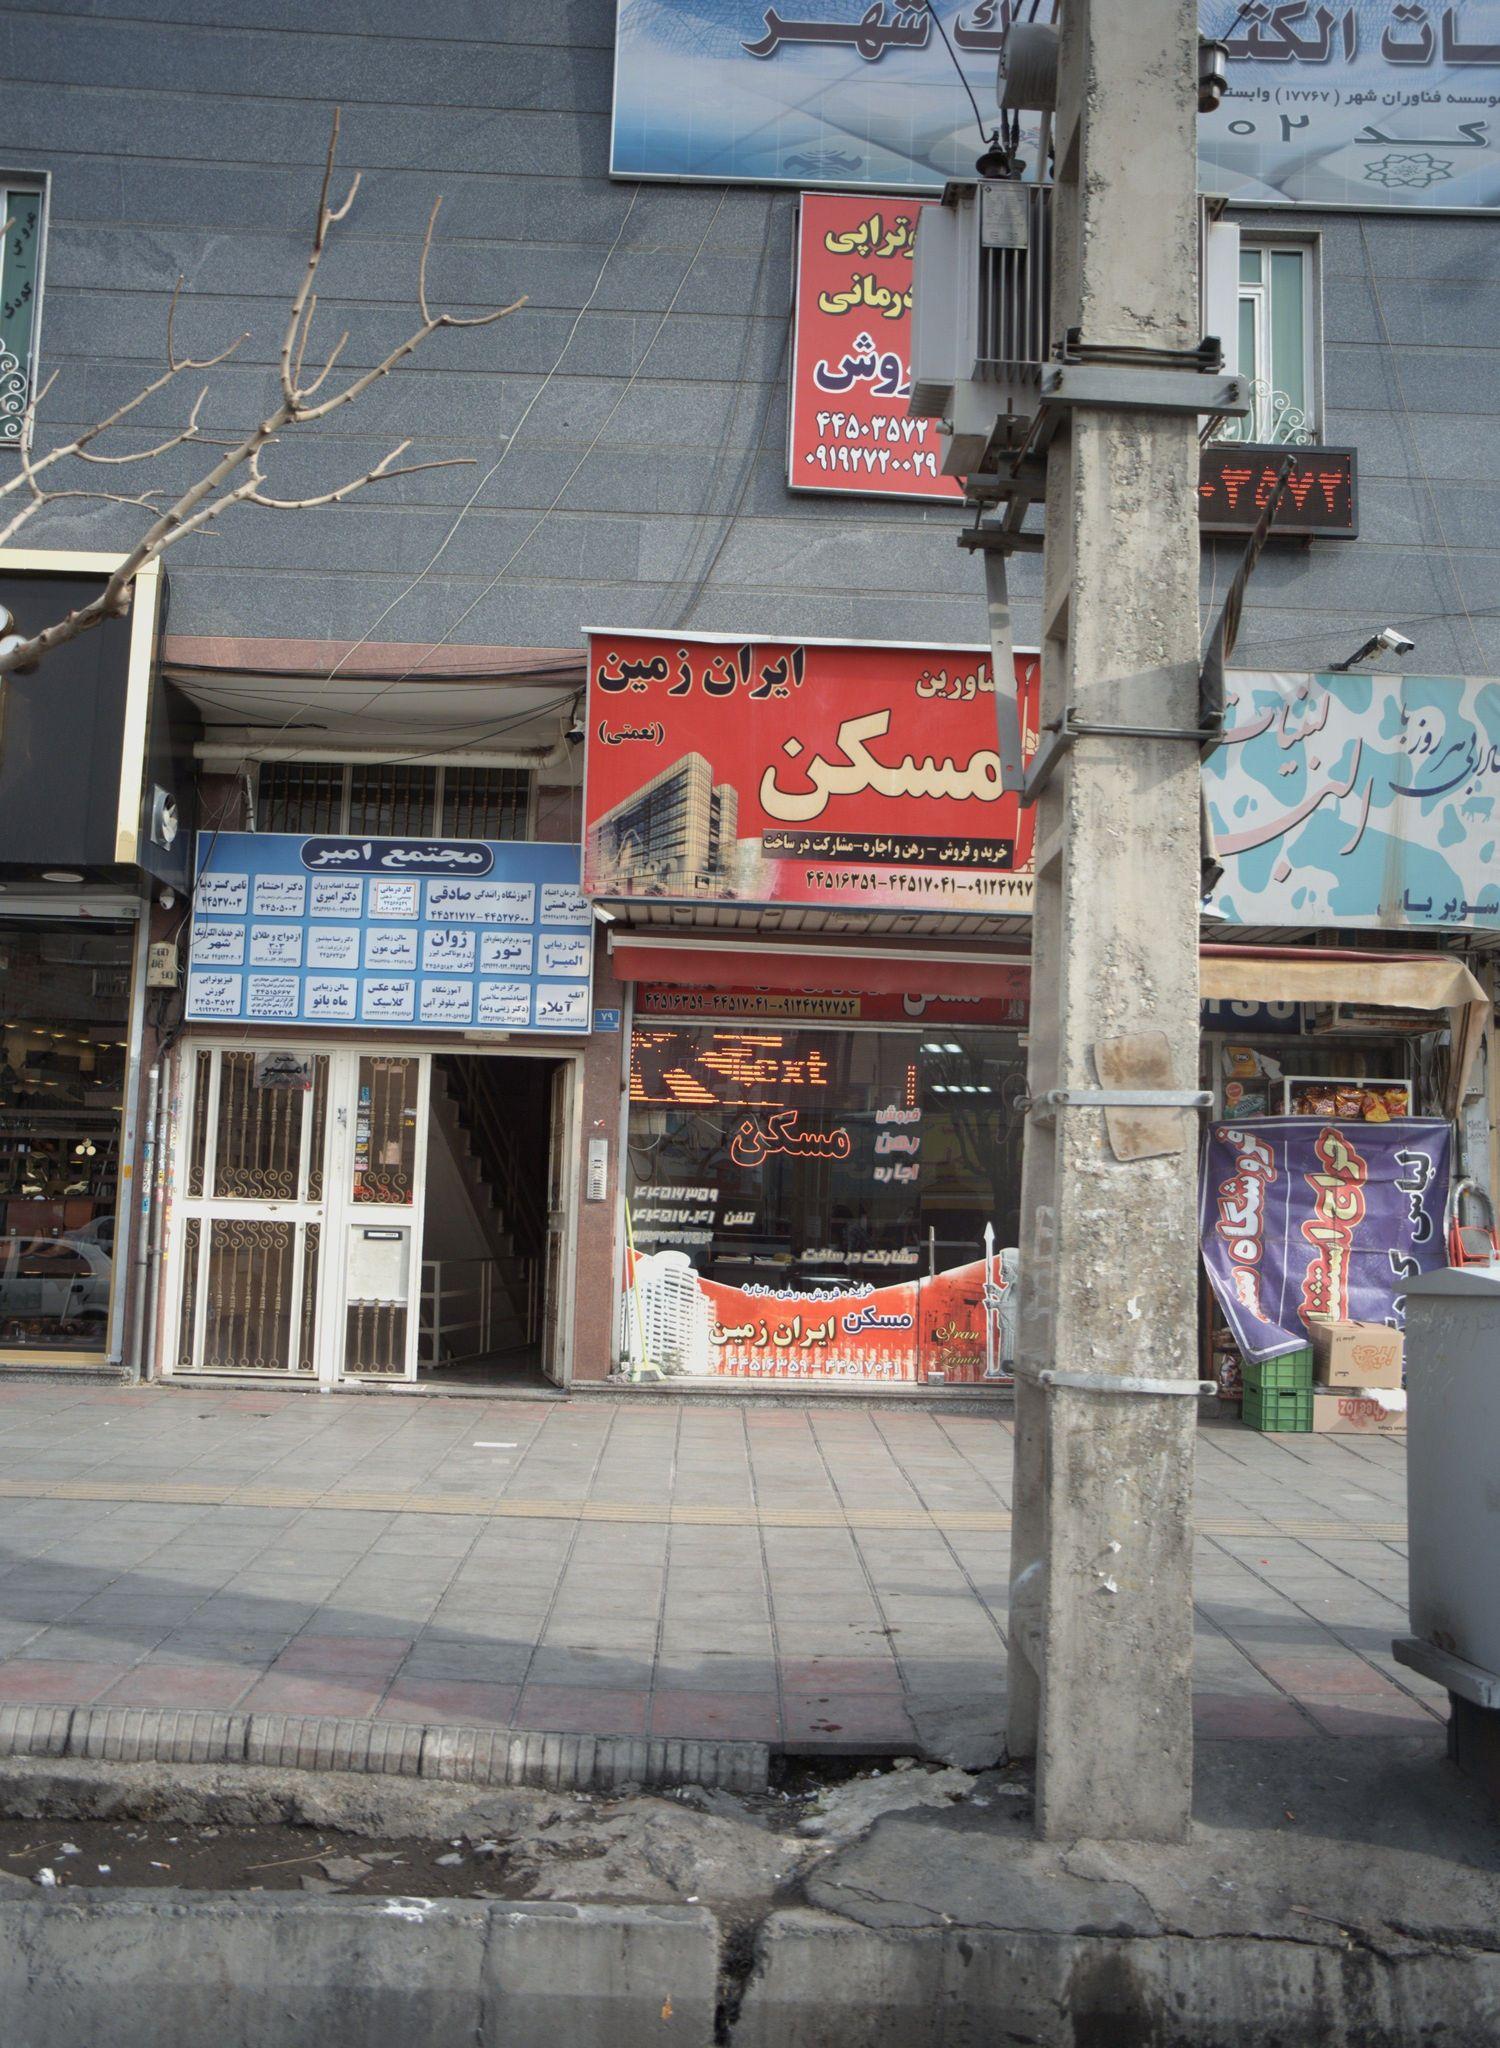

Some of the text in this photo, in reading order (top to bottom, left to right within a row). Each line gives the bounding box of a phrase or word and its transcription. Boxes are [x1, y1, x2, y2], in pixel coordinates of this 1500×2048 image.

[1345, 89, 1377, 105] شهر
[1382, 91, 1442, 107] فناوران
[816, 410, 929, 444] ۴۴۵۰۳۵۷۲
[597, 642, 805, 699] ایران زمین
[759, 709, 1005, 822] مسکن
[764, 834, 795, 849] ساخت
[797, 838, 809, 854] در
[310, 842, 483, 867] مجتمع امیر
[901, 845, 925, 859] رهن
[940, 844, 971, 861] فروش
[980, 847, 1008, 862] خرید
[286, 882, 303, 893] دکتر
[430, 885, 531, 904] آموزشگاه رانندگی صادقی
[339, 892, 357, 904] دکتر
[1438, 896, 1499, 921] سوپر
[207, 939, 230, 950] شهر
[277, 932, 301, 942] ازدواج
[544, 940, 585, 950] سالن زیبایی
[492, 944, 521, 960] نور
[546, 955, 582, 968] المیرا
[368, 982, 410, 993] آتلیه عکس
[432, 986, 462, 995] آموزشگاه
[313, 995, 348, 1008] ماه بانو
[372, 998, 404, 1008] کلاسیک
[539, 1001, 573, 1015] آیلار
[875, 1105, 920, 1124] فروش
[731, 1110, 850, 1167] مسکن
[874, 1163, 919, 1184] اجاره
[1304, 1128, 1368, 1228] حراج
[1216, 1126, 1277, 1264] فروشگاه
[1394, 1150, 1436, 1242] لباس
[741, 1283, 769, 1298] اجاره
[842, 1305, 913, 1334] مسکن
[708, 1315, 836, 1347] ایران زمین
[936, 1320, 980, 1341] Iran
